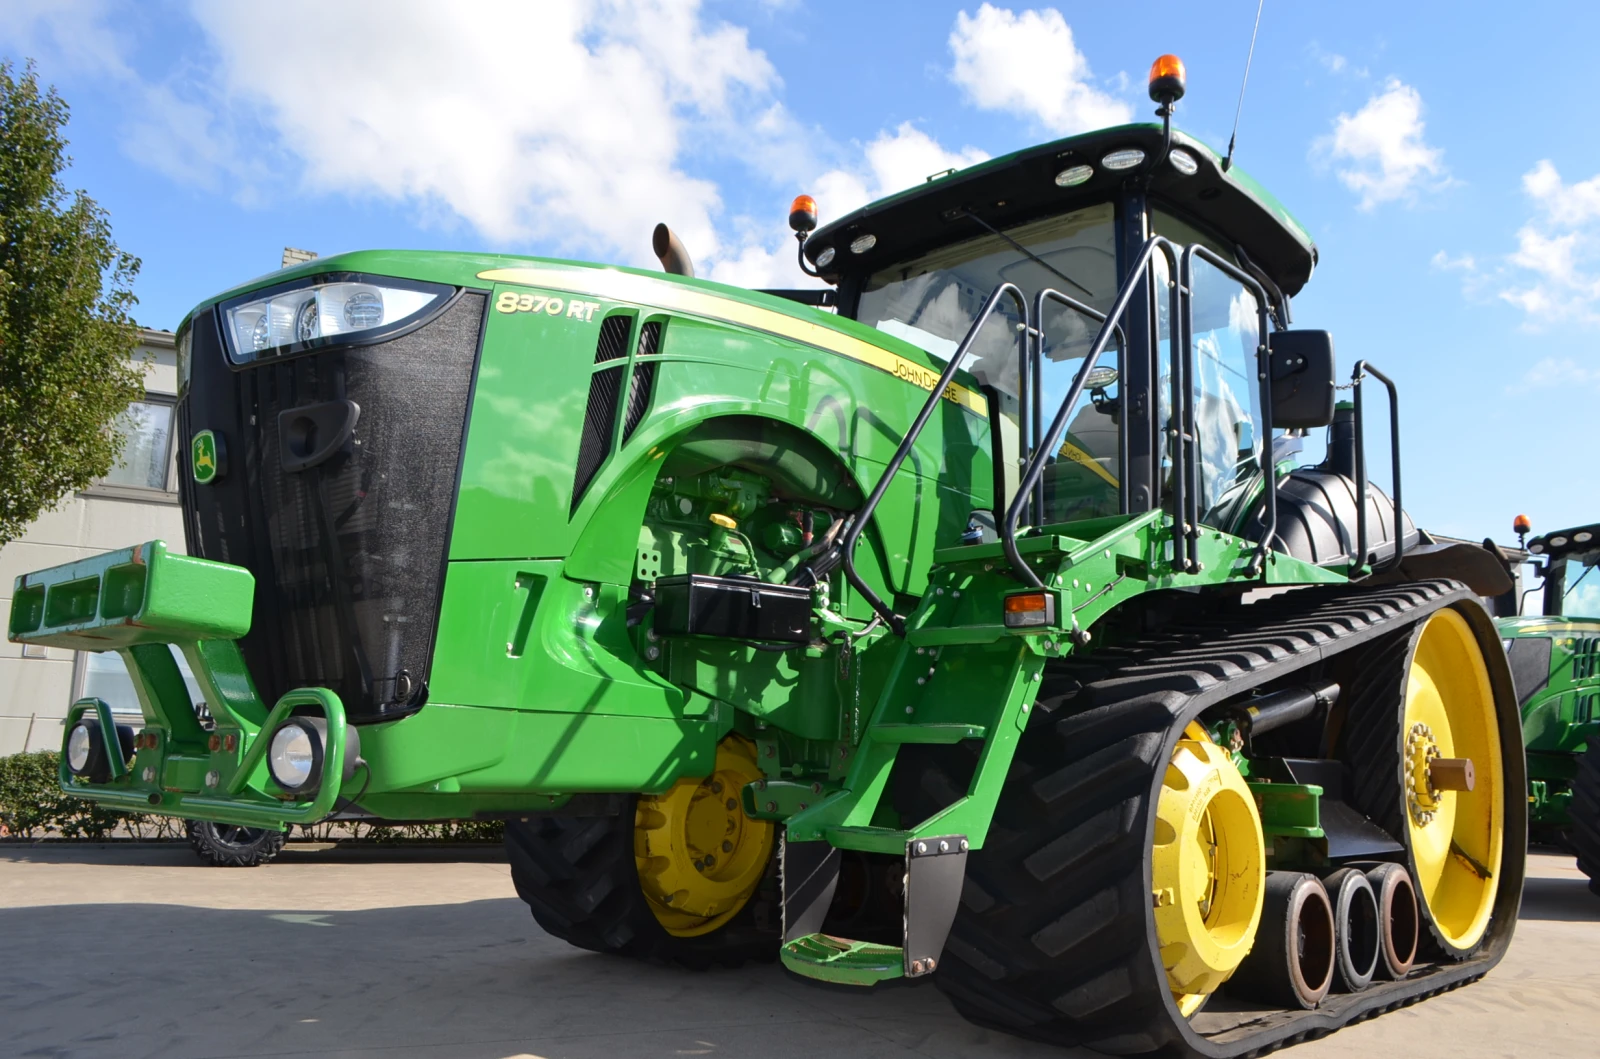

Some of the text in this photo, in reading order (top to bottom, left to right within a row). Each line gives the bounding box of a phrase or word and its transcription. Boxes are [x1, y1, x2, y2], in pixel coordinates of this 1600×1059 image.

[496, 292, 600, 322] 8370 RT
[893, 359, 958, 401] JOHN DERE
